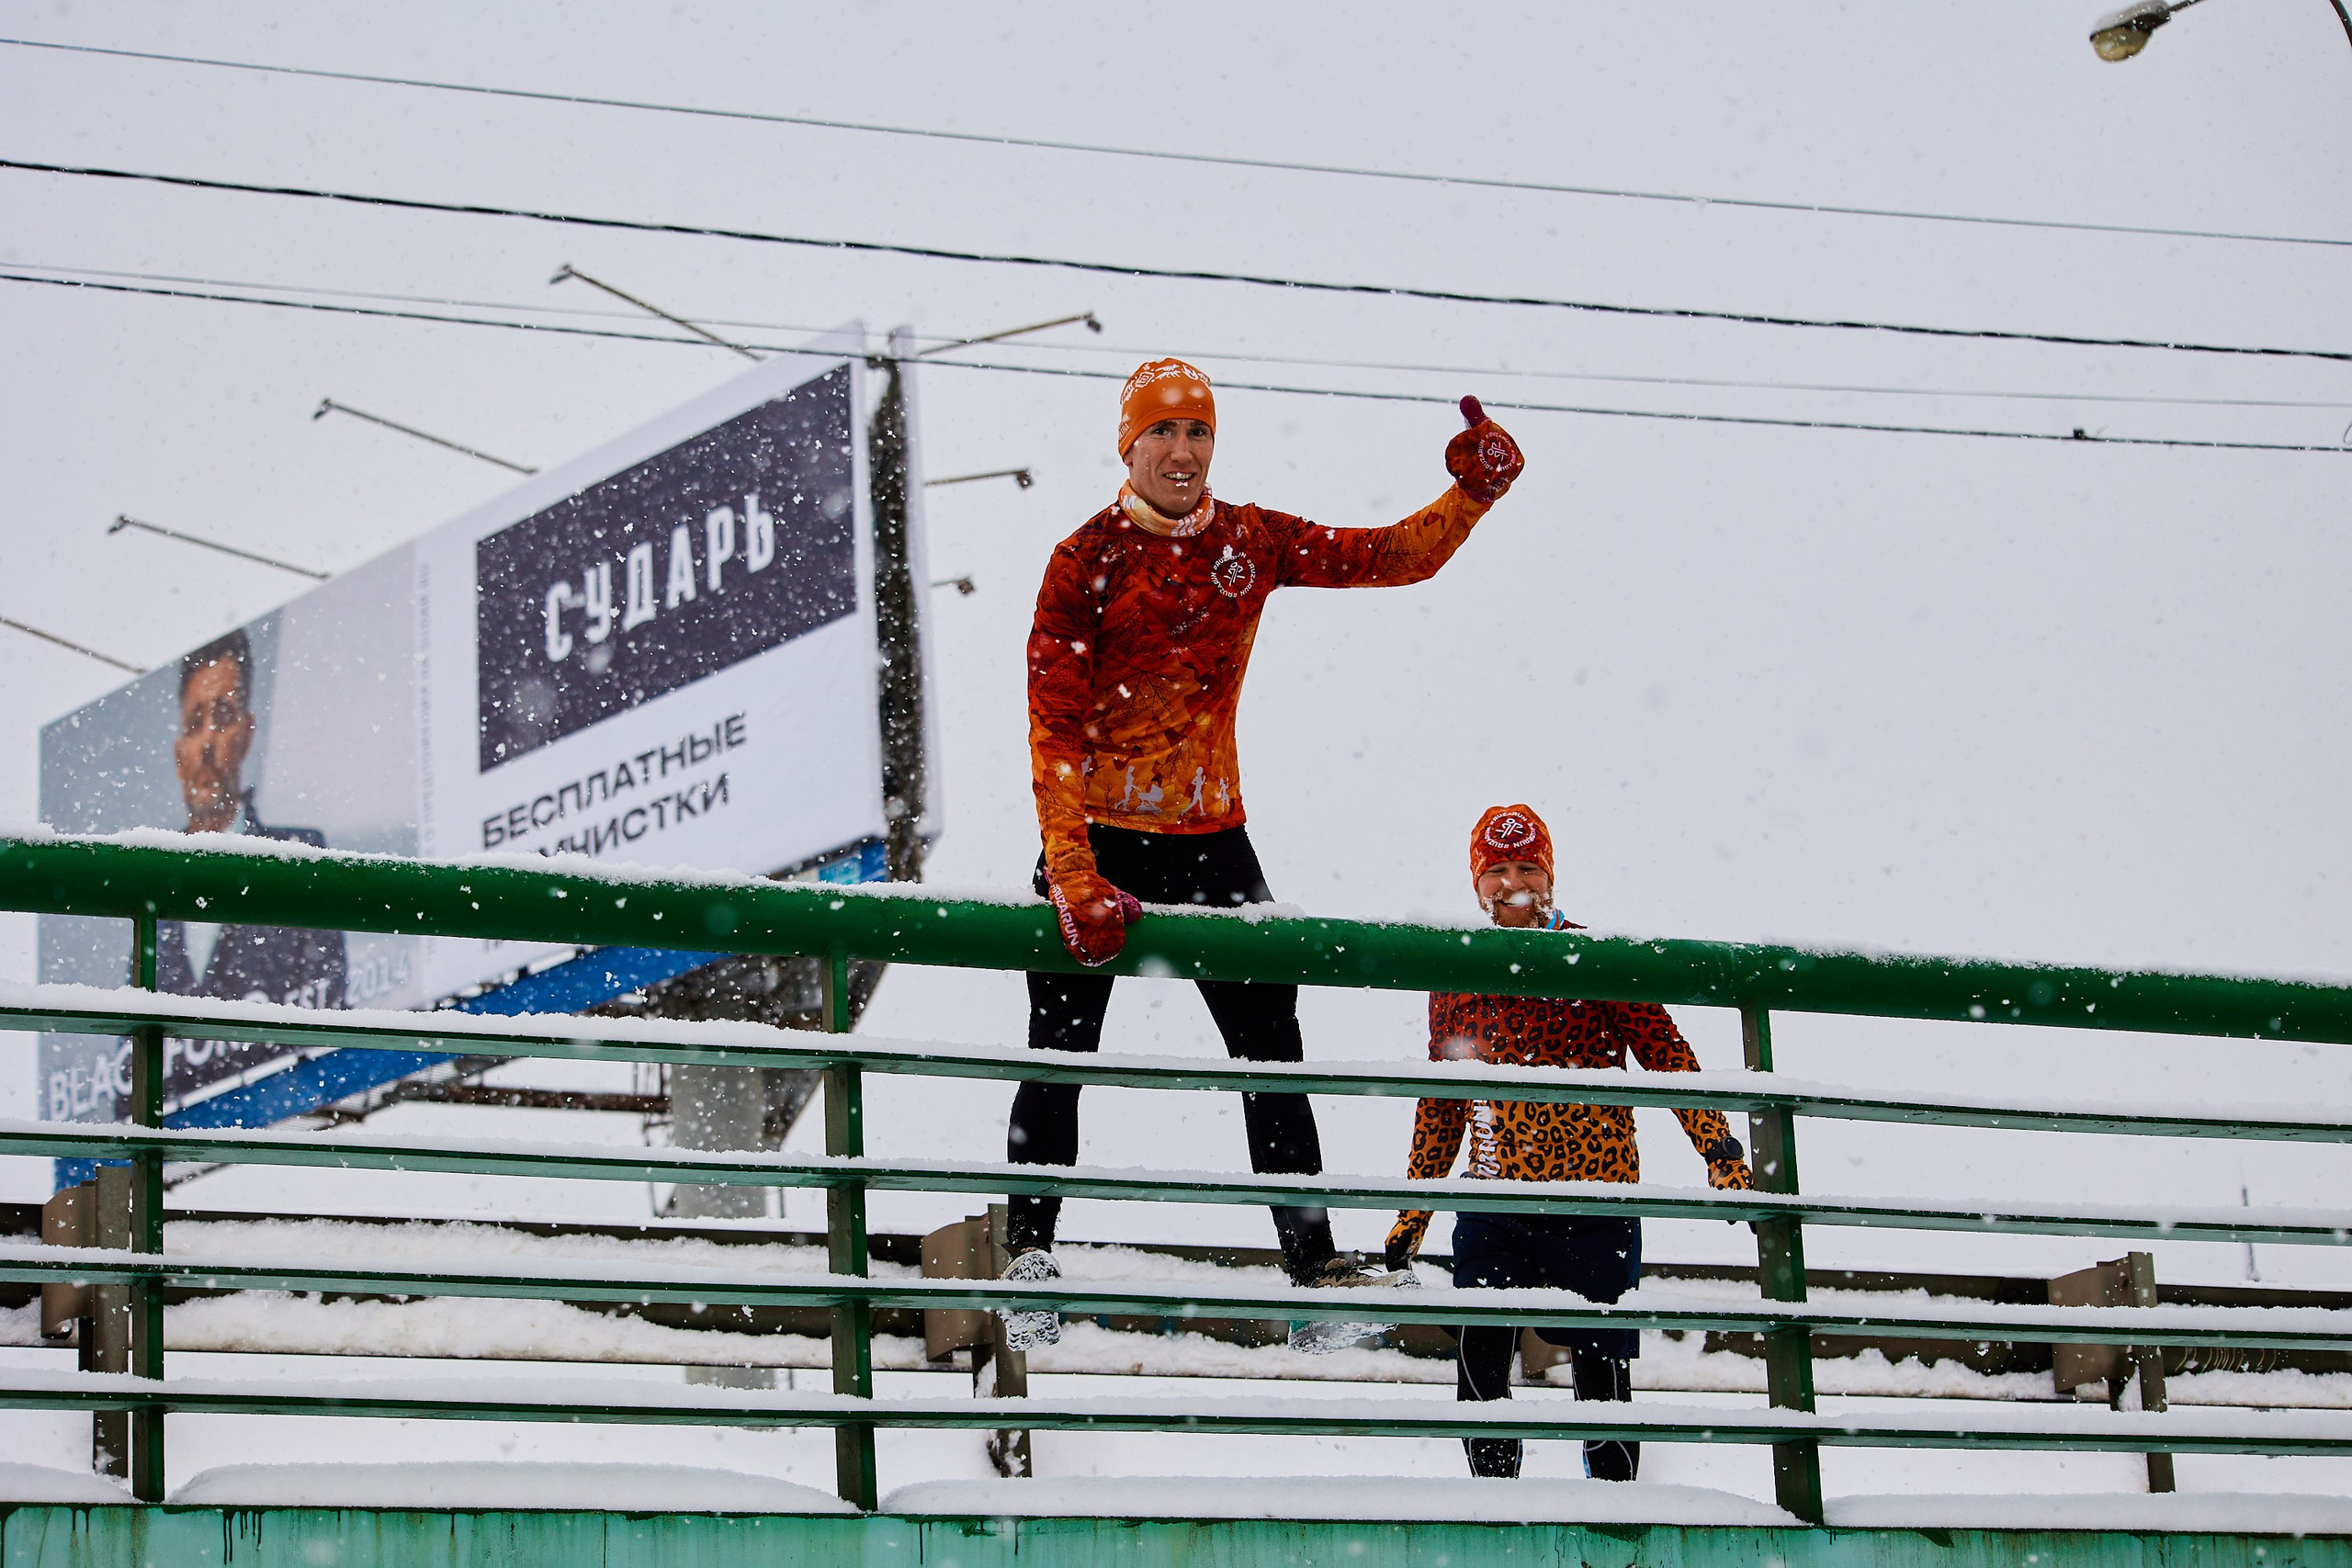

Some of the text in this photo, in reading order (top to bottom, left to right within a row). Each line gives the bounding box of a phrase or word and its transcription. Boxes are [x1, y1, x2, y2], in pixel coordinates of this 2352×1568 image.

[546, 491, 775, 662] СУДАРЬ
[482, 711, 746, 849] БЕСПЛАТНЫЕ
[344, 948, 409, 1005] 2014
